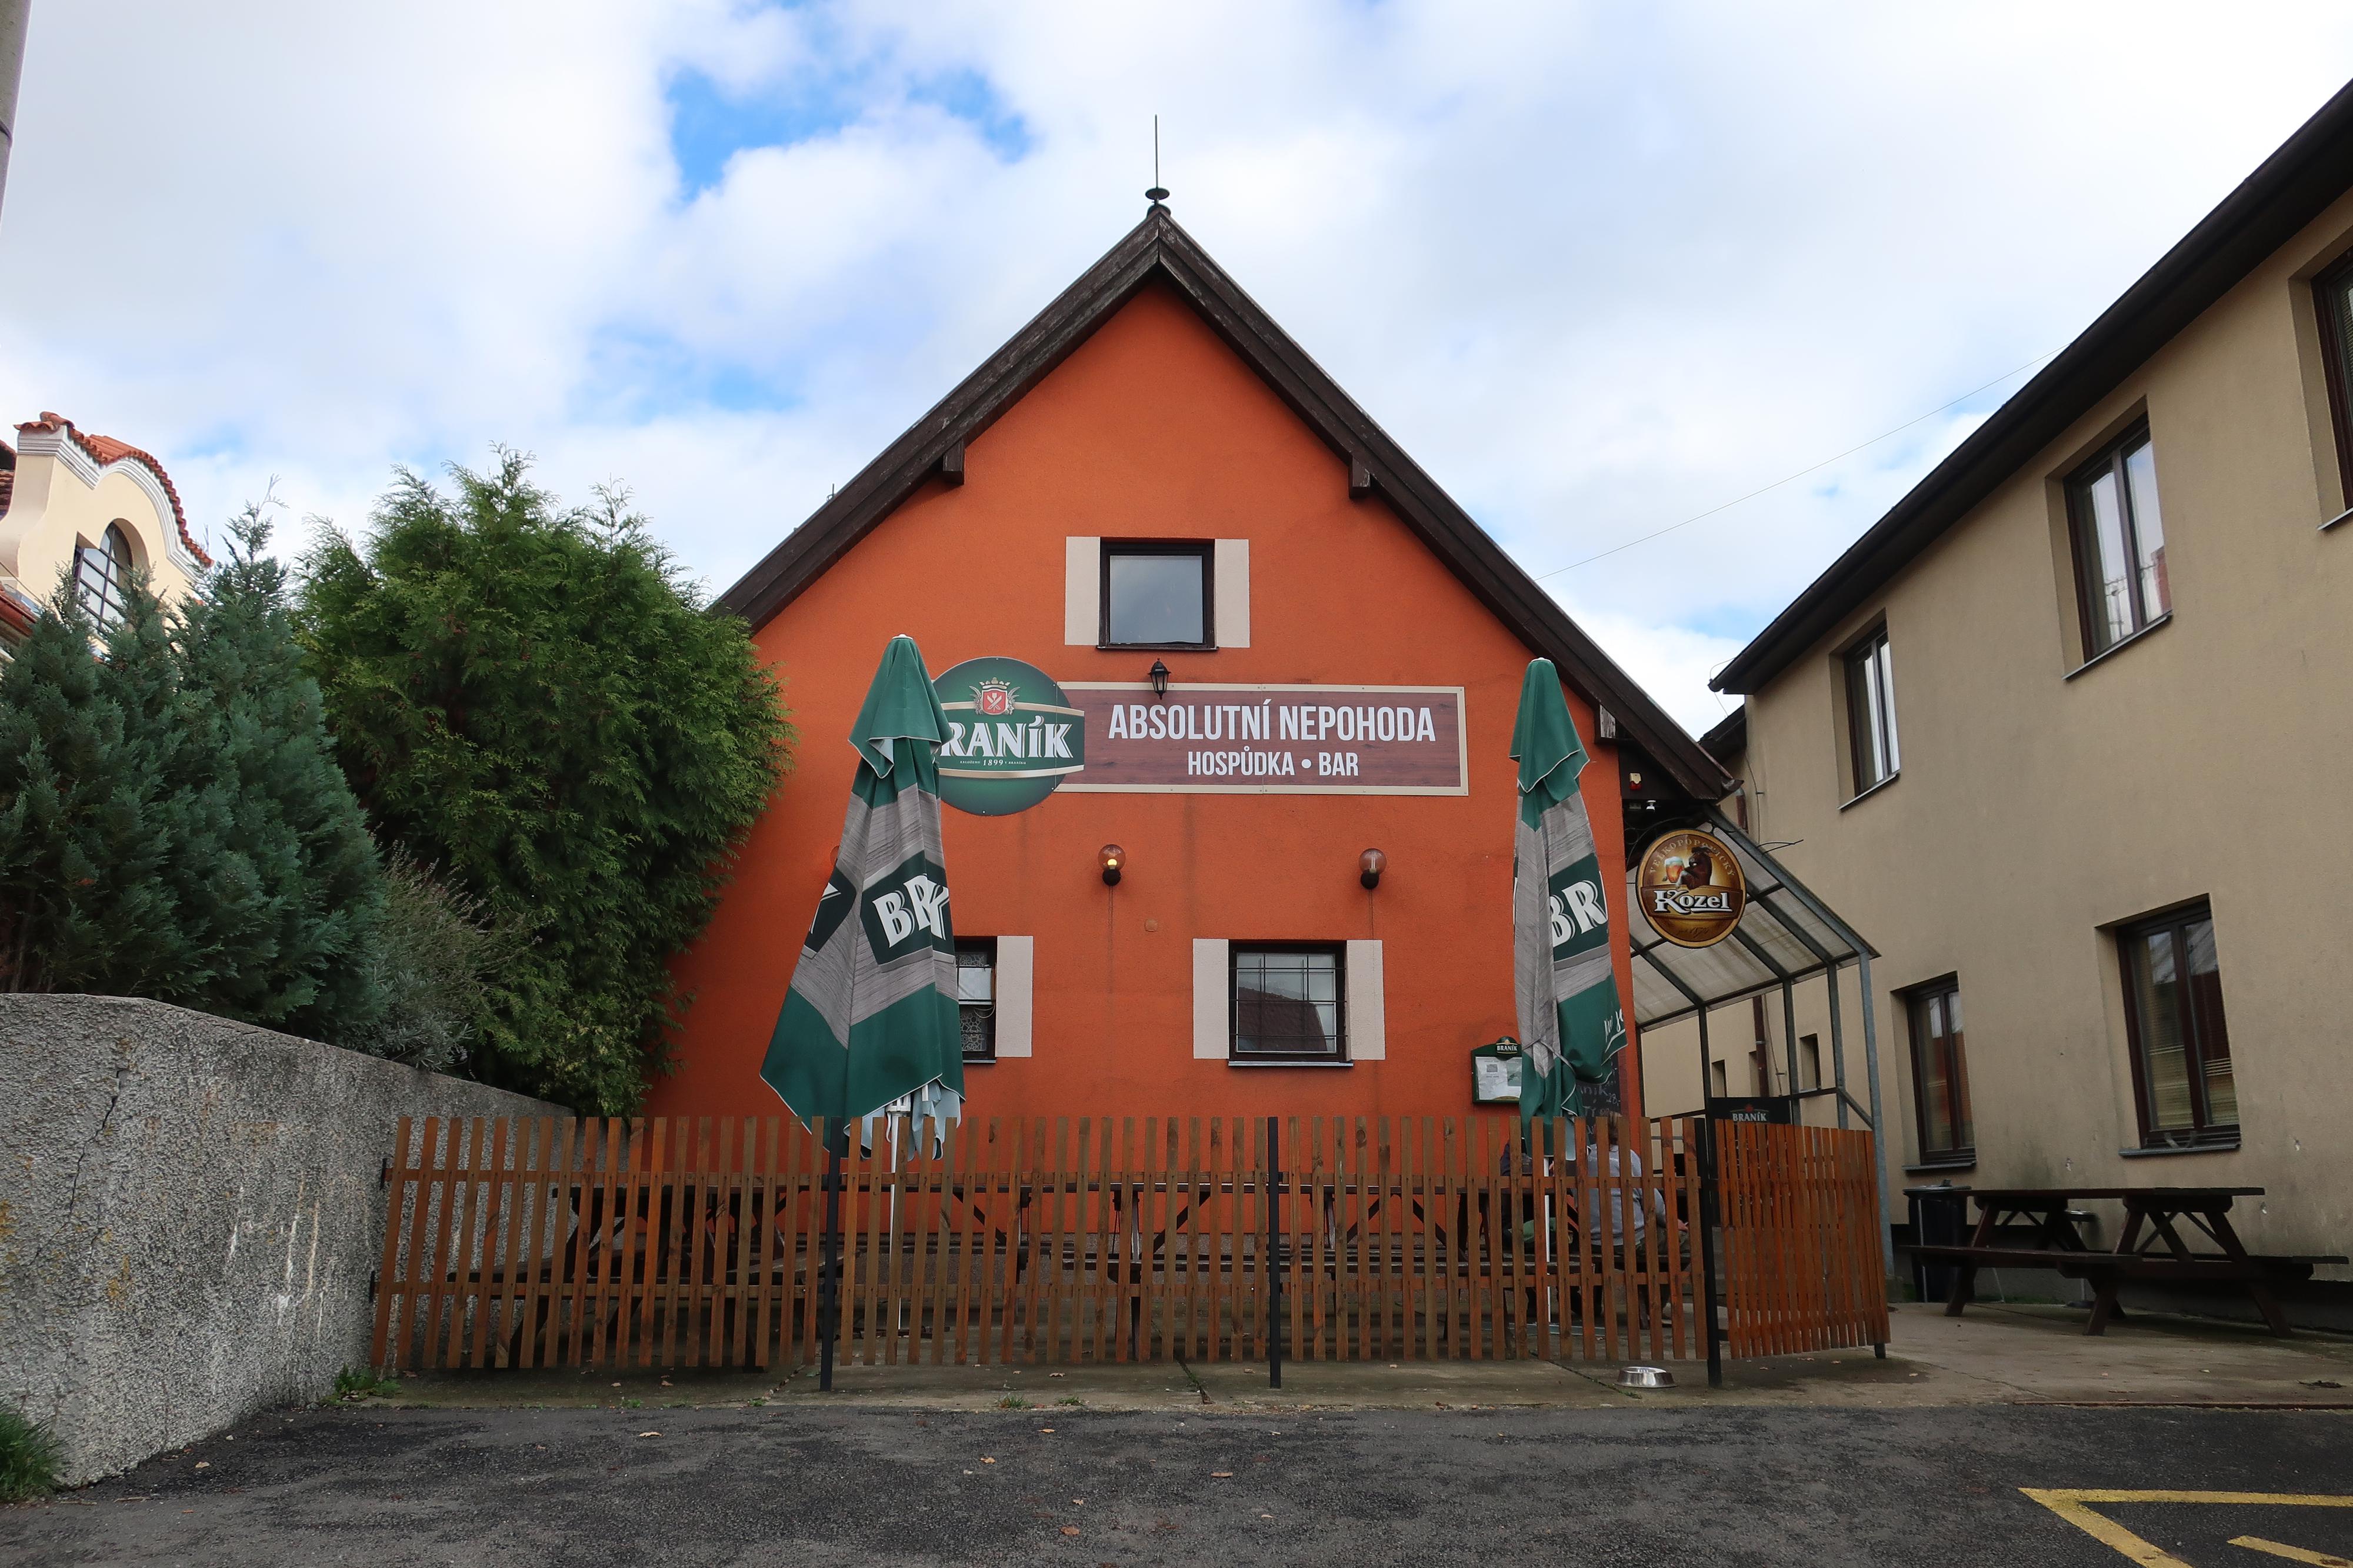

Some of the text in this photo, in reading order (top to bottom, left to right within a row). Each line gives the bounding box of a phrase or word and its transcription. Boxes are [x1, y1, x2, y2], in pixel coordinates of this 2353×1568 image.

[1108, 699, 1436, 742] ABSOLUTNÍ NEPOHODA
[940, 715, 1074, 759] RANÍK
[1188, 745, 1359, 776] HOSPŮDKA BAR
[1654, 889, 1733, 914] Kozel
[1732, 1111, 1767, 1122] BRANÍK
